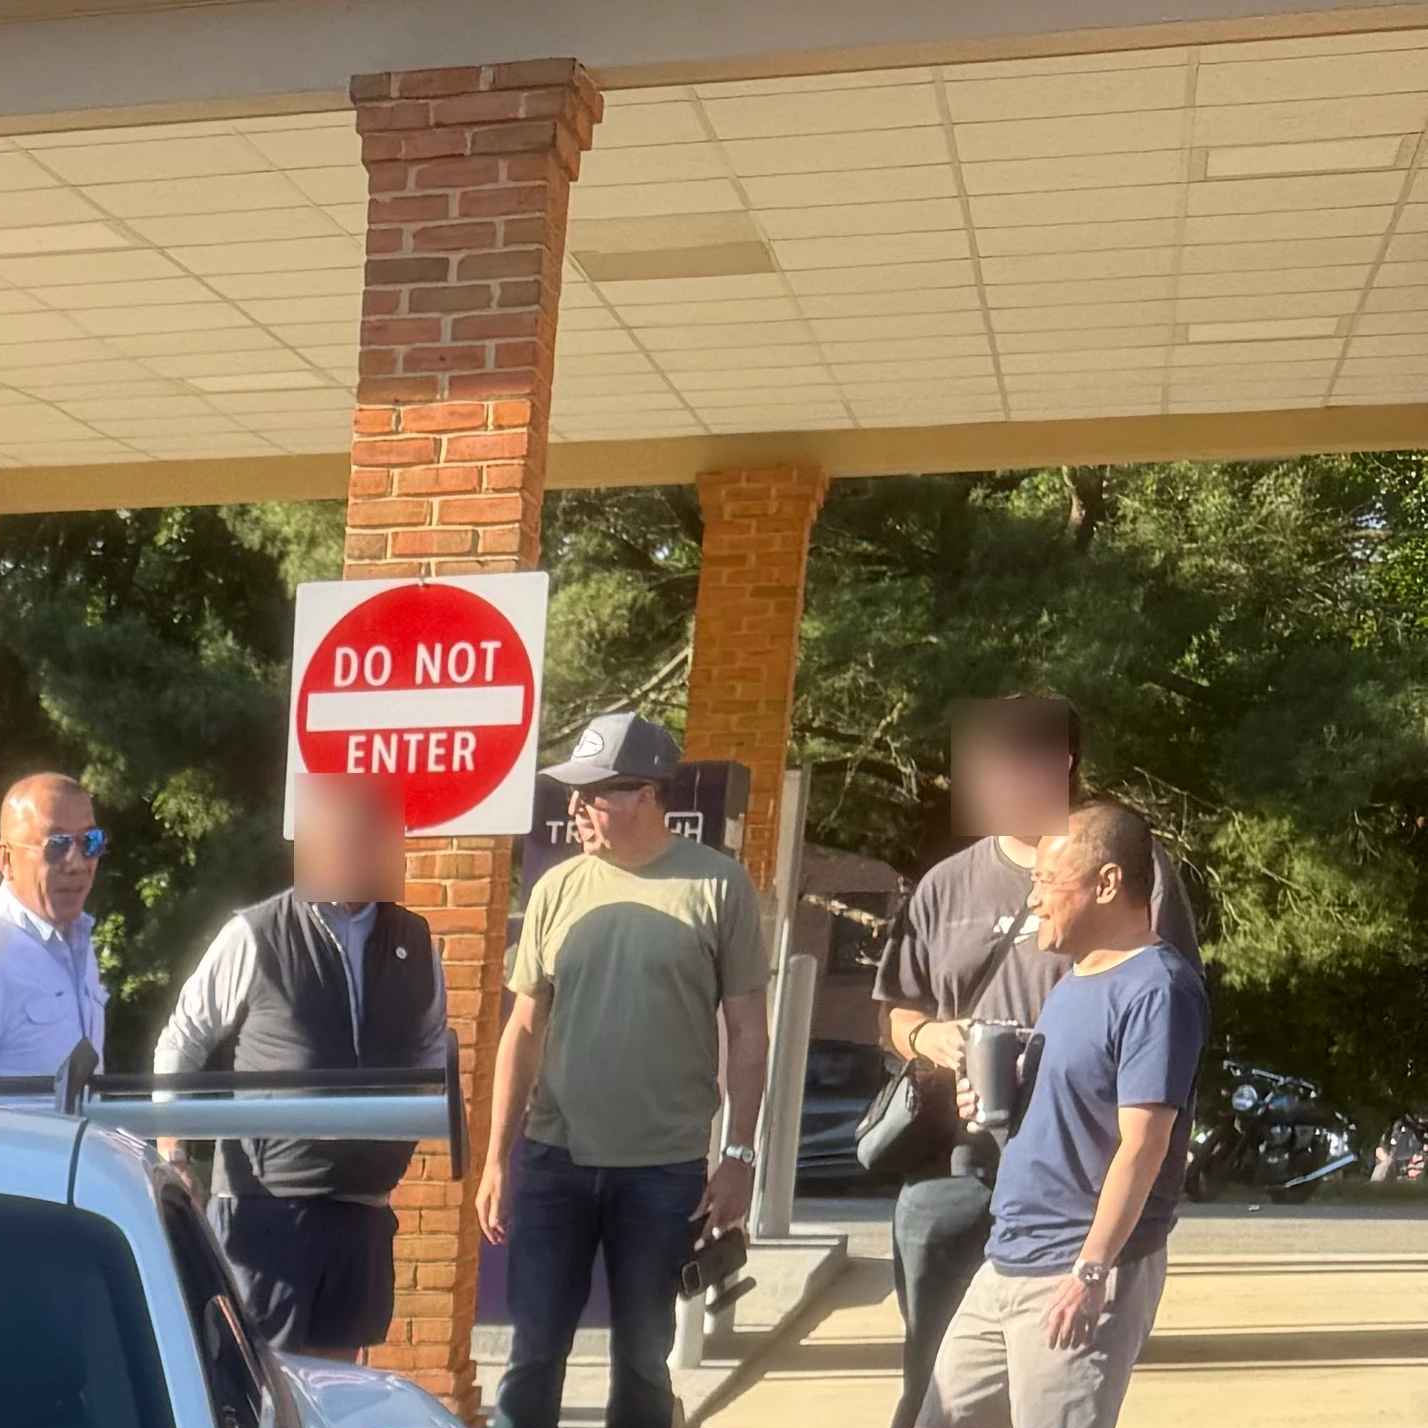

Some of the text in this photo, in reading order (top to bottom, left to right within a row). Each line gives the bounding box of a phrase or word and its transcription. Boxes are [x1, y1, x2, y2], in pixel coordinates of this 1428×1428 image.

[333, 641, 502, 687] DO NOT
[347, 732, 477, 774] ENTER
